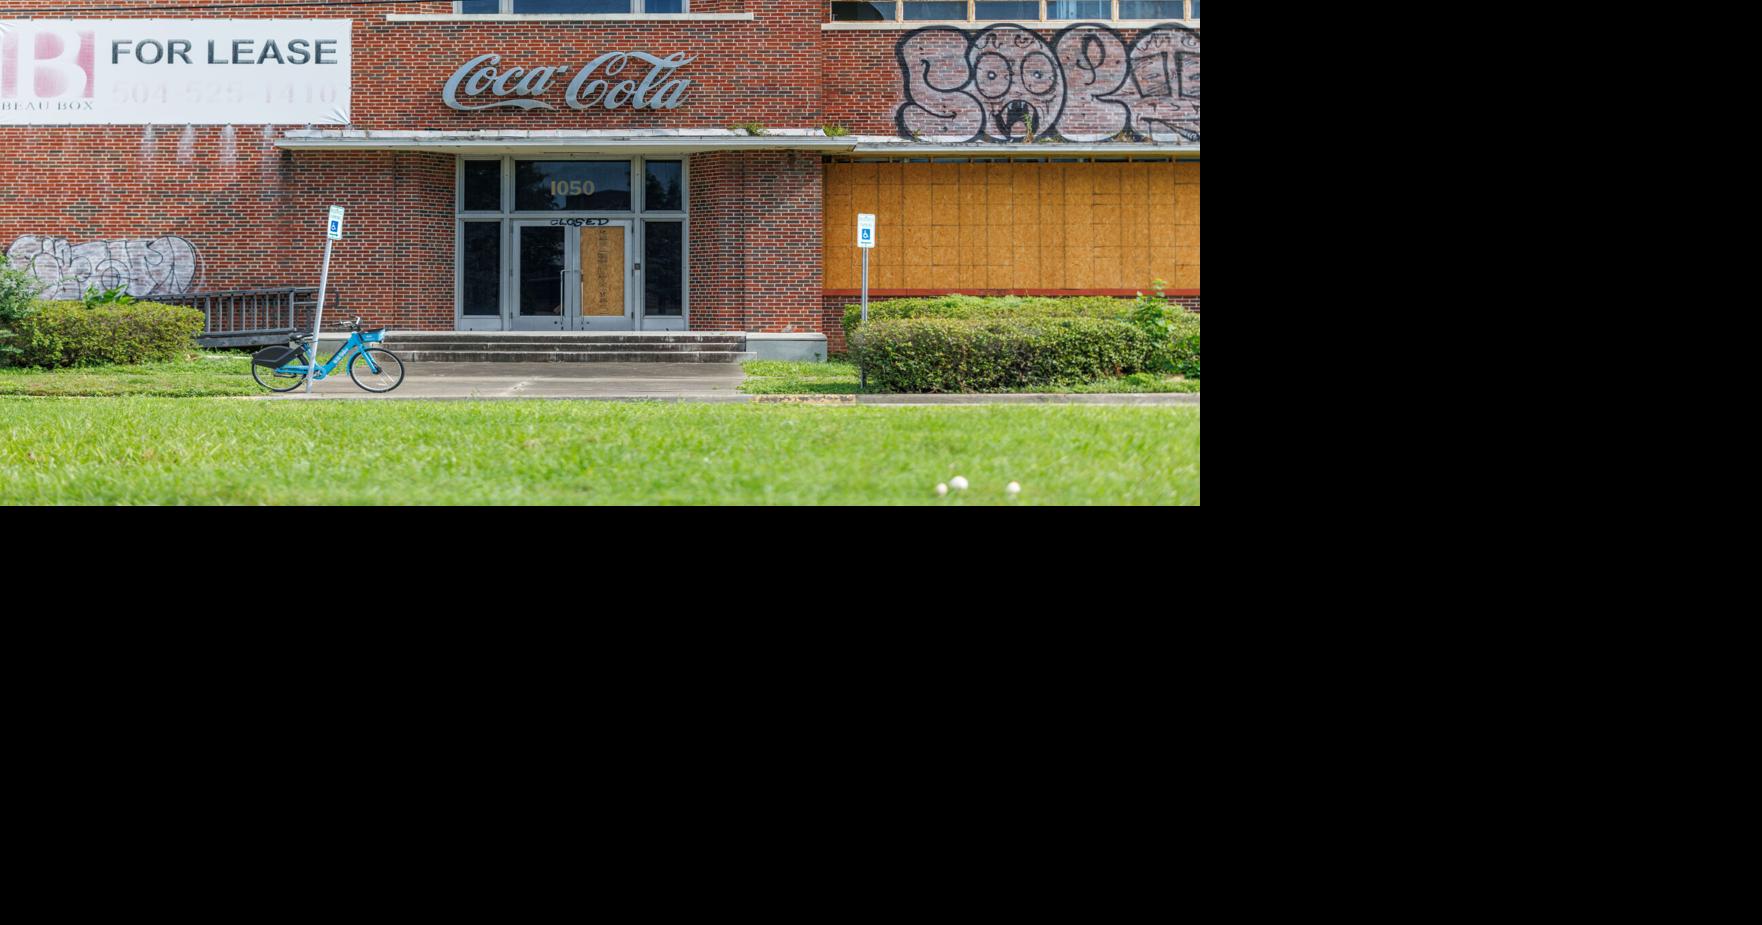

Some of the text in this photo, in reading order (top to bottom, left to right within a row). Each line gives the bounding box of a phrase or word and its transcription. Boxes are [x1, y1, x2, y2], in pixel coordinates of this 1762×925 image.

[111, 39, 338, 65] FOR LEASE
[2, 101, 92, 110] BEAU BOX
[551, 180, 596, 196] 1050
[550, 217, 609, 227] CLOSED
